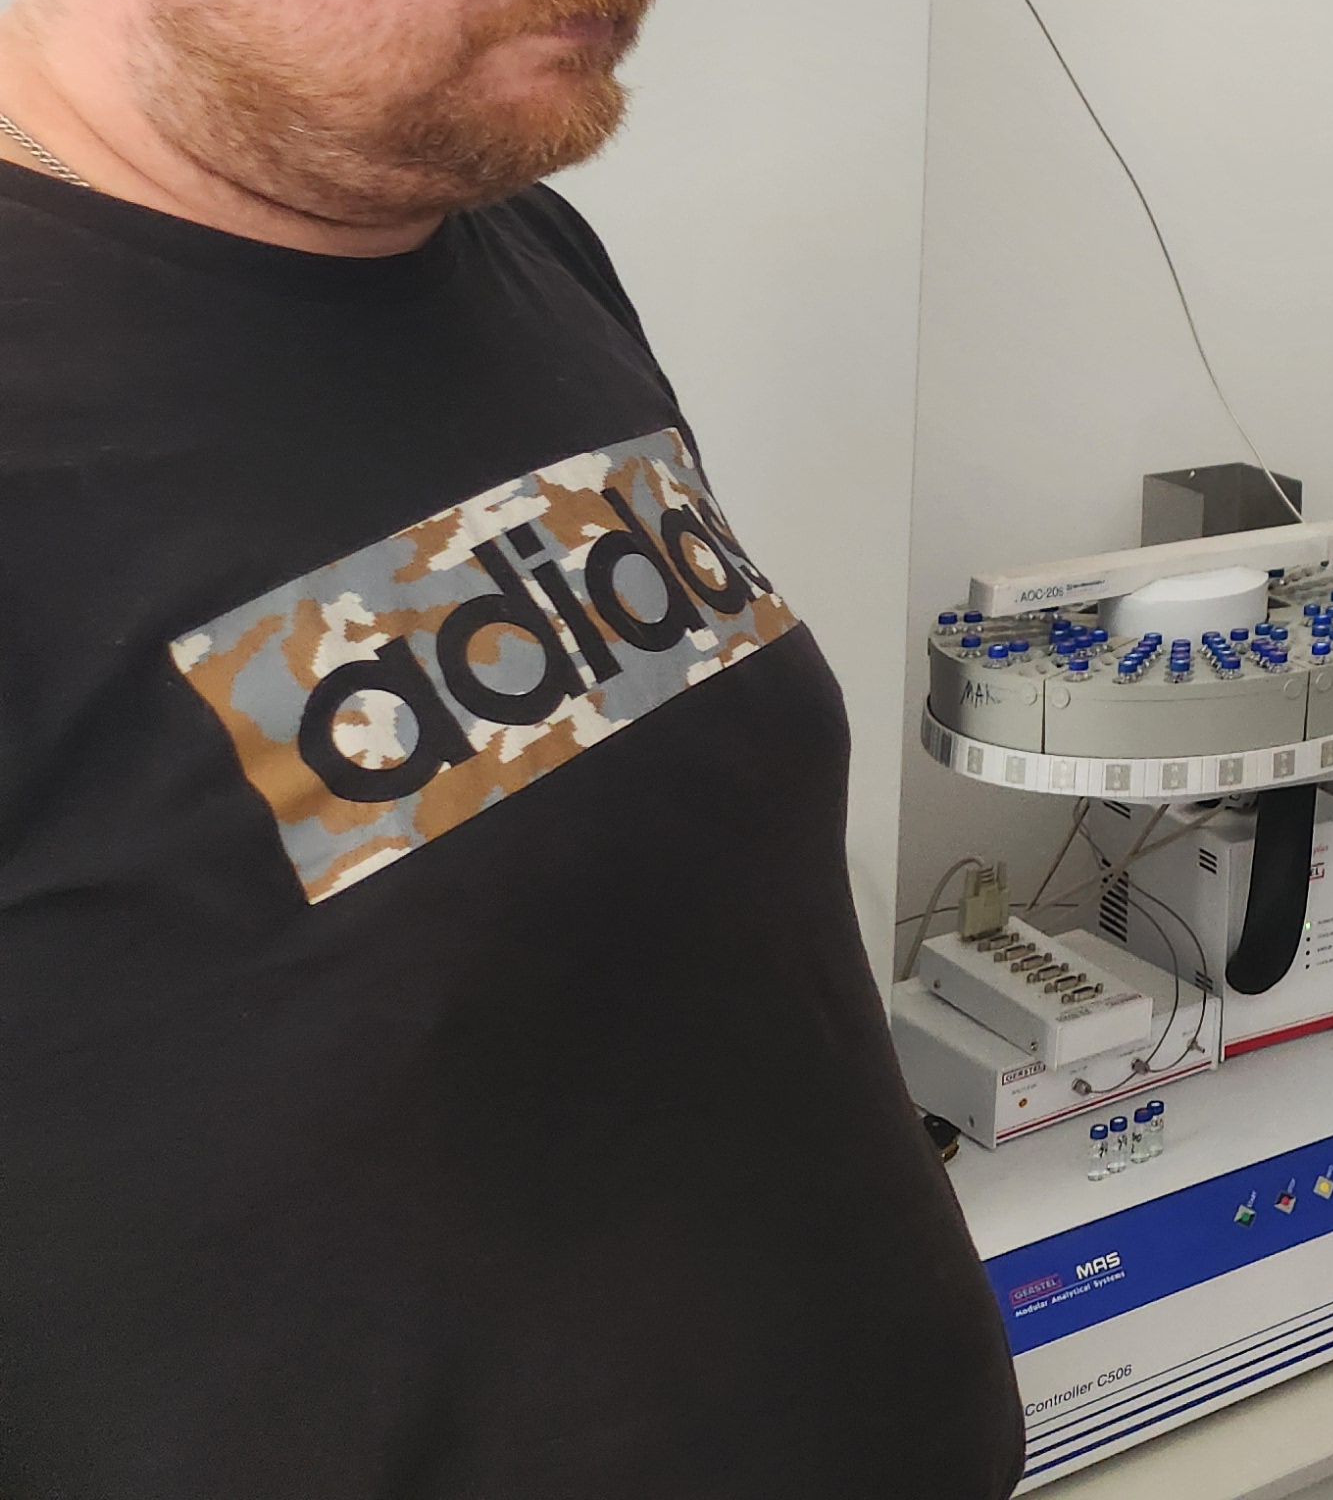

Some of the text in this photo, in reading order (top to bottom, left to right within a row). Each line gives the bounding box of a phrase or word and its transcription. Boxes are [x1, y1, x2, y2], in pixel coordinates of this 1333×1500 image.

[298, 486, 774, 804] adidas
[1013, 1278, 1058, 1300] GERSTEL
[1075, 1251, 1121, 1280] MAS
[1015, 1270, 1126, 1318] Modular Analytical Systems
[1024, 1364, 1133, 1417] Controller C506
